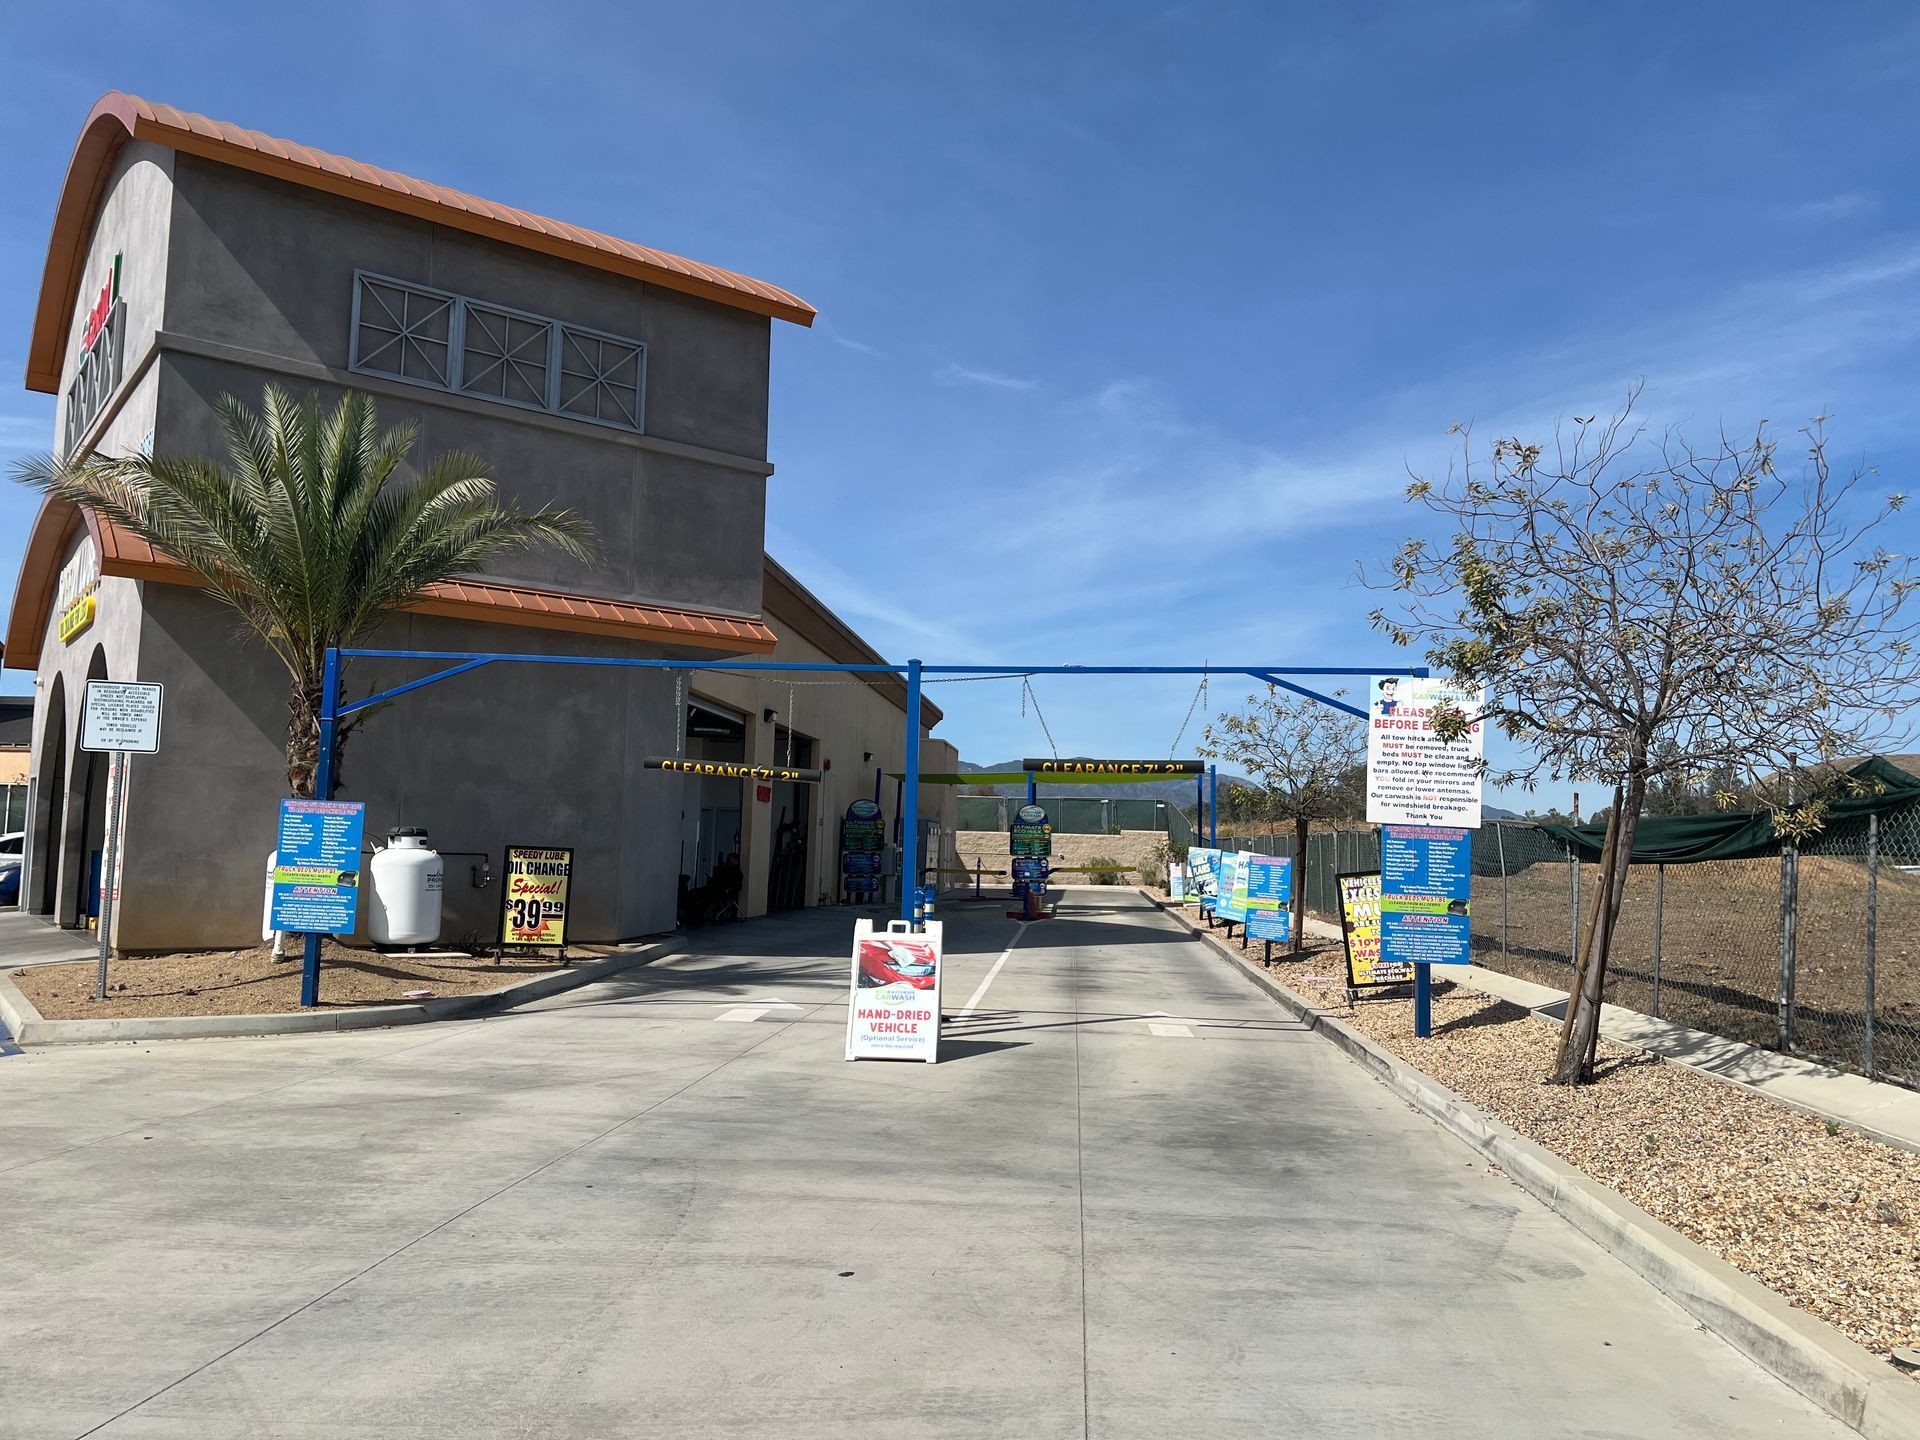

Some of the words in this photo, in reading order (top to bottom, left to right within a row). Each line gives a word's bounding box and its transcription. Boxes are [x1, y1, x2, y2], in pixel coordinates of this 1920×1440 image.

[1390, 706, 1432, 718] PLEASE
[1375, 719, 1418, 730] BEFORE
[662, 760, 758, 778] CLEARANCE
[1042, 762, 1140, 774] CLEARANCE
[1433, 804, 1468, 812] breakage.
[514, 850, 543, 859] SPEEDY
[545, 852, 565, 861] LUBE
[508, 861, 524, 874] OIL
[526, 862, 569, 876] CHANGE
[512, 878, 563, 896] Special!
[1344, 878, 1381, 888] VEHICLES
[293, 886, 338, 894] ATTENTION
[1402, 915, 1448, 924] ATTENTION
[858, 1009, 931, 1021] HAND-DRIED
[870, 1022, 918, 1033] VEHICLE
[861, 1034, 894, 1042] (Optional
[896, 1036, 925, 1044] Service)
